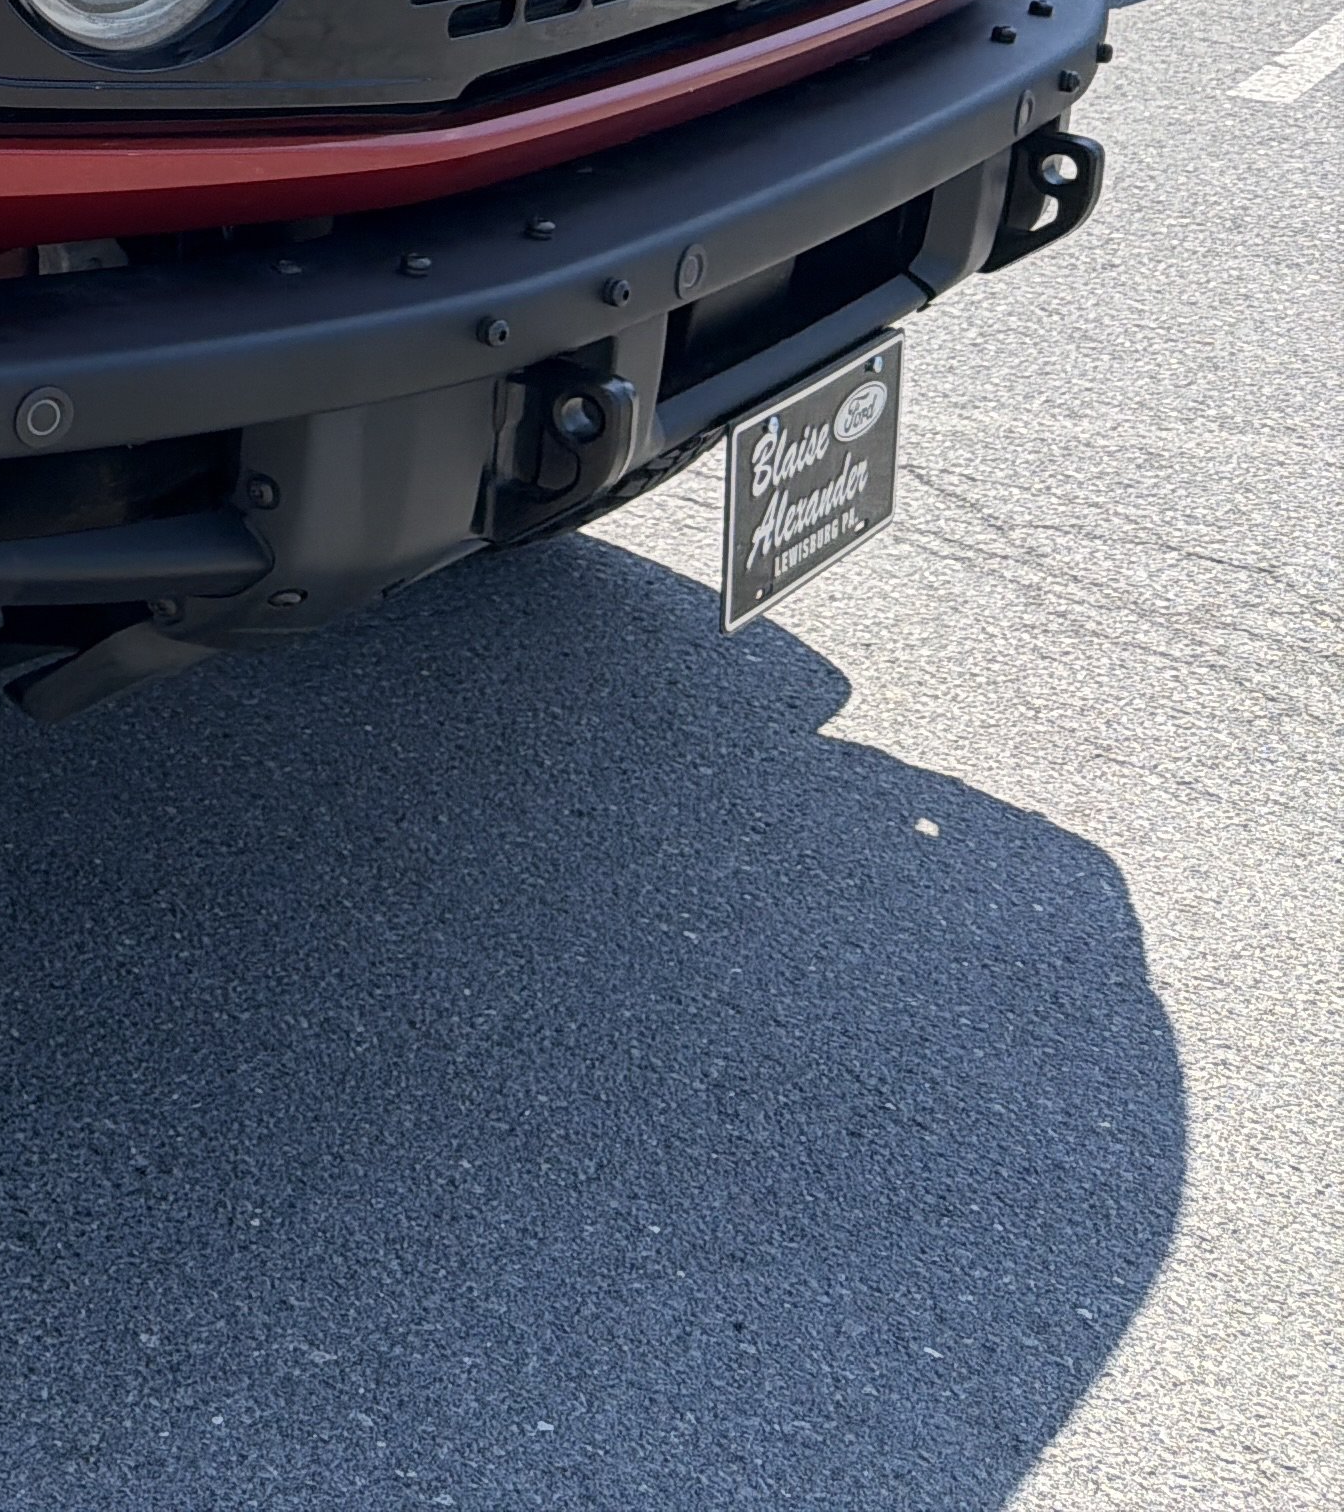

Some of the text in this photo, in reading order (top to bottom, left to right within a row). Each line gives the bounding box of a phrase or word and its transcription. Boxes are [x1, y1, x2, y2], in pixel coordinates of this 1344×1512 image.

[842, 390, 880, 435] Ford
[752, 421, 830, 498] Blaise
[746, 450, 869, 572] Alexander
[774, 518, 839, 578] LEWISBURG
